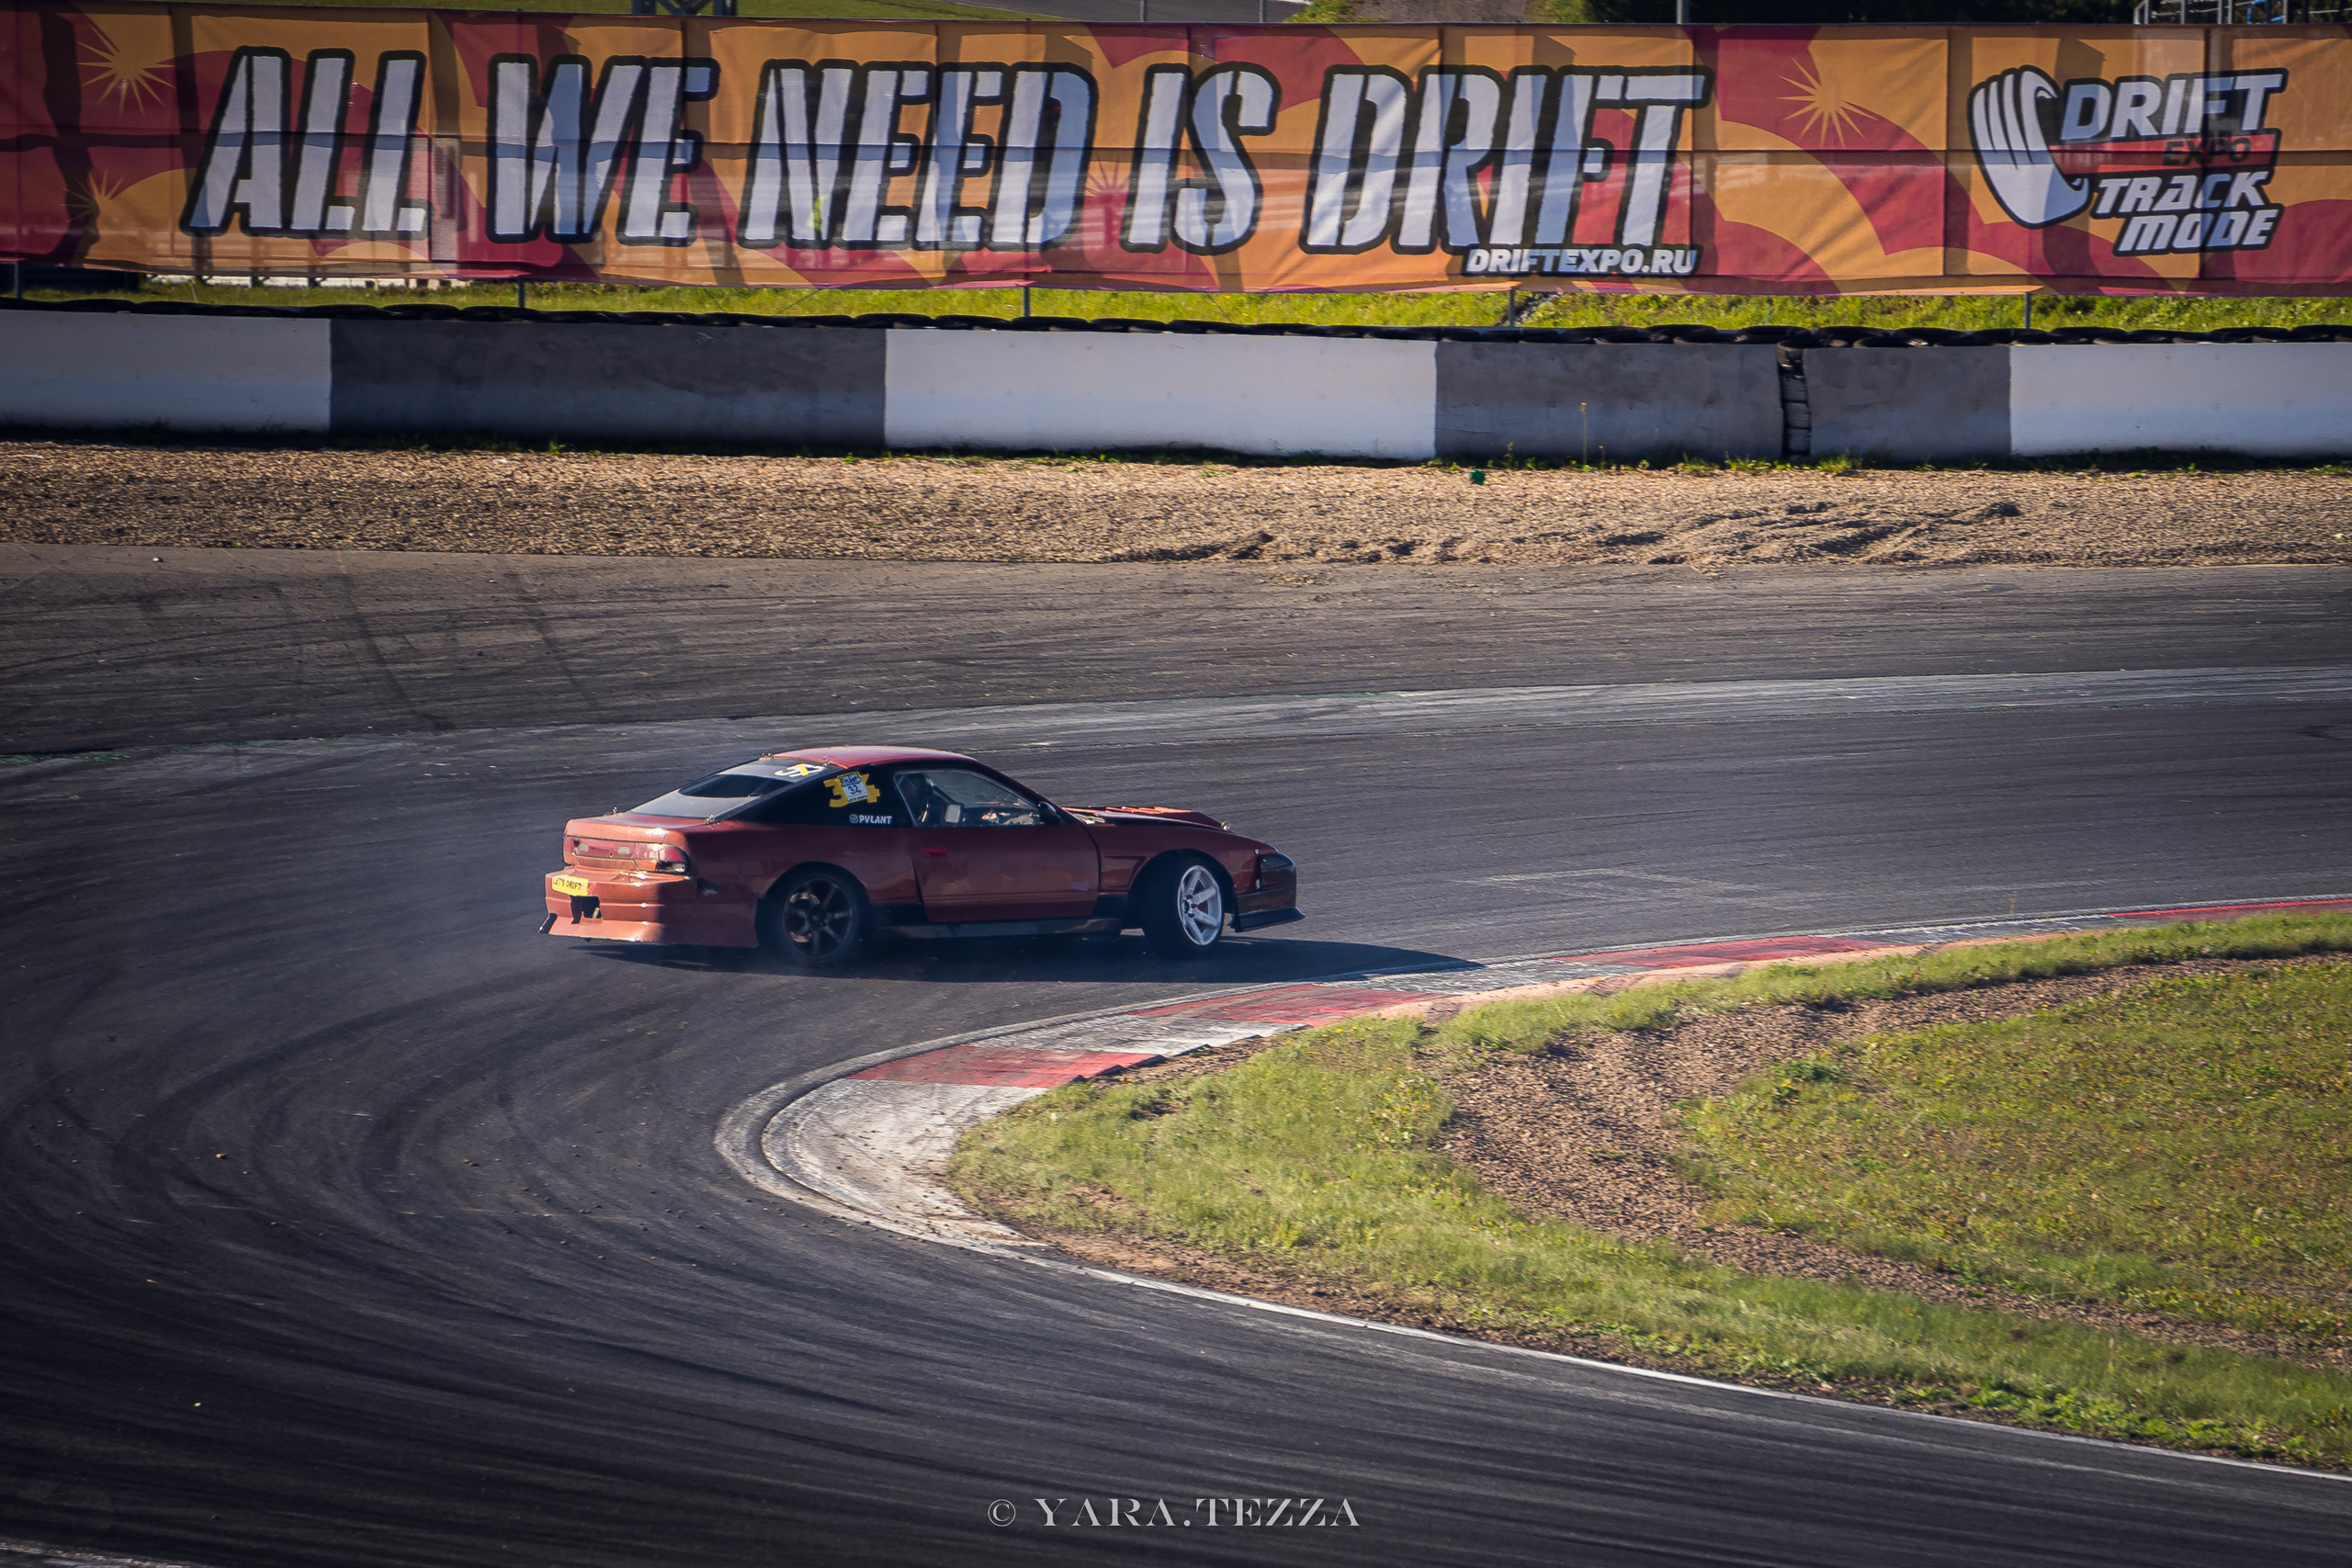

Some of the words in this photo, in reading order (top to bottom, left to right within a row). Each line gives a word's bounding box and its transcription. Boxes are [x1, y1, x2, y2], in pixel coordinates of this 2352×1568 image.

[2060, 73, 2283, 141] DRIFT
[184, 49, 424, 236] ALL
[490, 58, 717, 243] WE
[741, 62, 1094, 247] NEED
[1124, 65, 1279, 253] IS
[1301, 68, 1710, 250] DRIFT
[2163, 137, 2253, 166] EXPO
[2096, 171, 2270, 214] TRACK
[2119, 209, 2279, 253] MODE
[1466, 248, 1697, 274] DRIFTEXPO.RU
[848, 784, 862, 795] 32
[553, 877, 565, 886] LET'S
[566, 880, 582, 890] DRIFT
